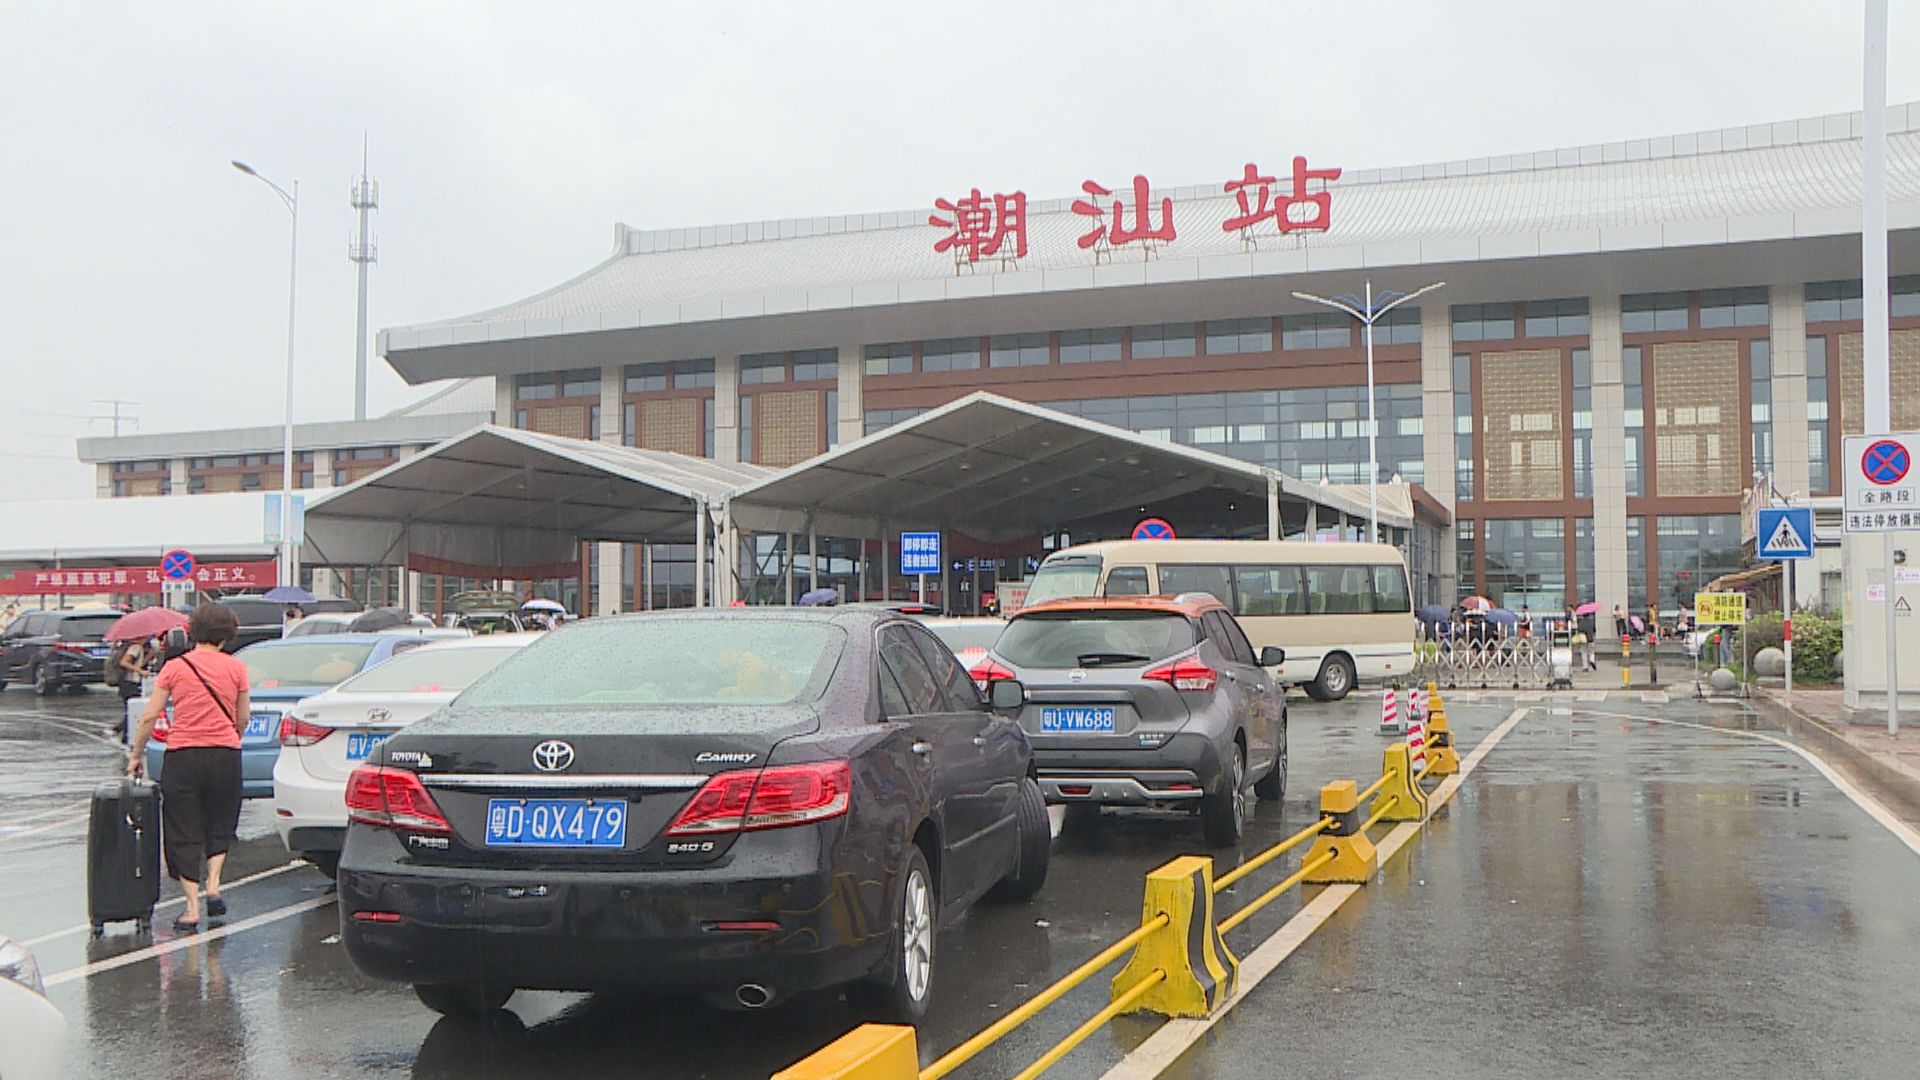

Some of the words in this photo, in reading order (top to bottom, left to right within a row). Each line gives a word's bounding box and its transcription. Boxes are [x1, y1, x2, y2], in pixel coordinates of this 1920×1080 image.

[929, 156, 1342, 262] 潮汕站
[1864, 490, 1909, 503] 全路段
[904, 536, 938, 551] 即停即走
[904, 553, 938, 568] 违者拍照
[1713, 610, 1743, 622] 禁止停车
[391, 751, 421, 762] TOYOTA
